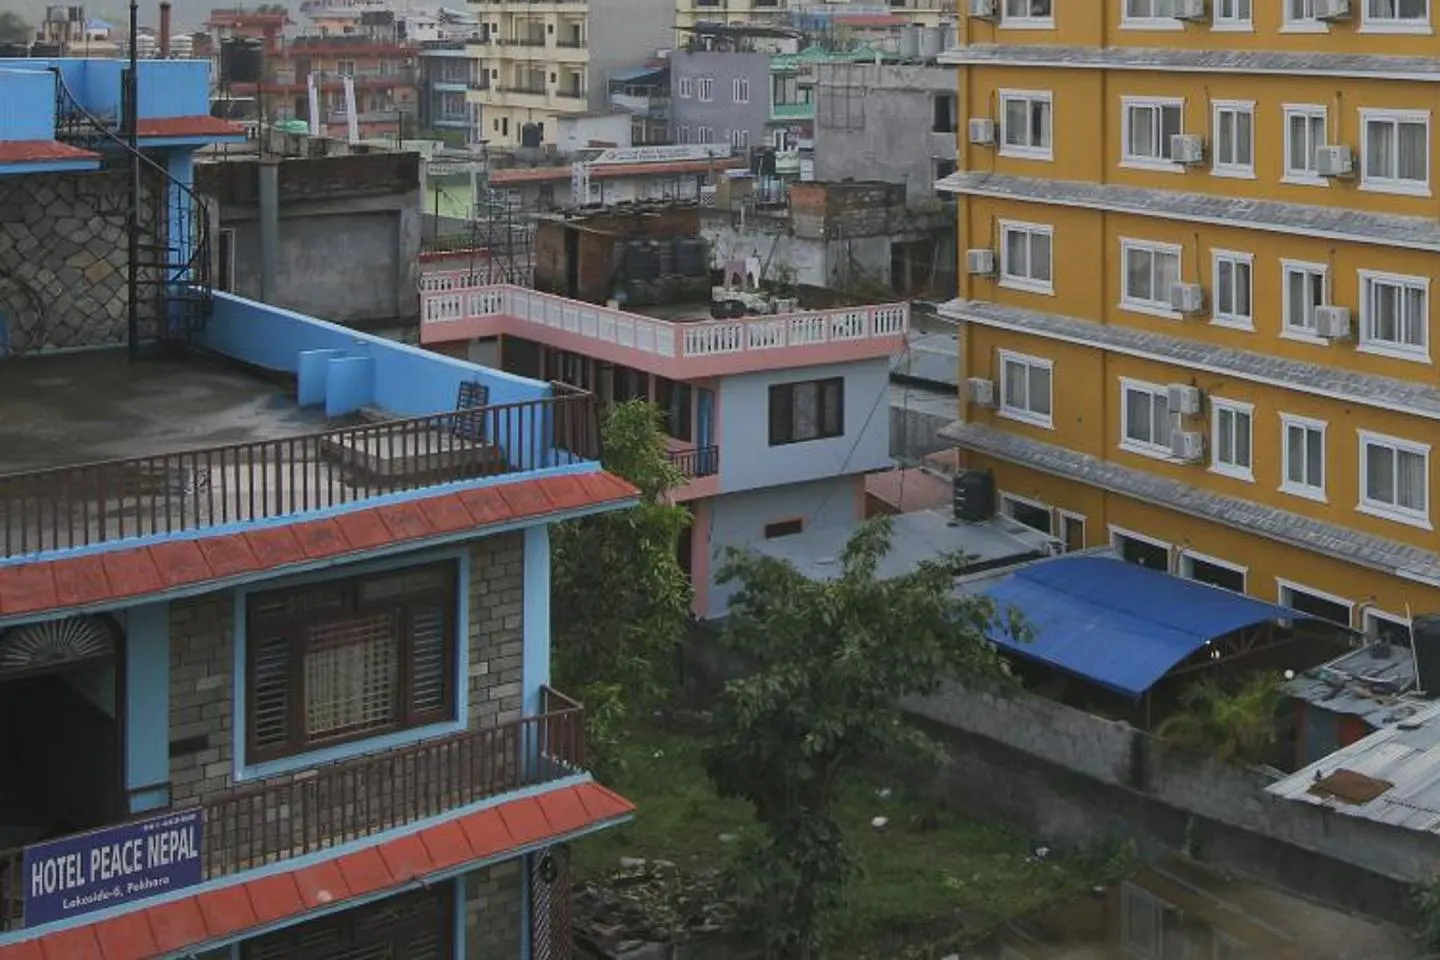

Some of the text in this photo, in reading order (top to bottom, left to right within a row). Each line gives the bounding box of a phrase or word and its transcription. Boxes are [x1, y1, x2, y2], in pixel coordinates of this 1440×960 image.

[32, 825, 198, 897] HOTEL PEACE NEPAL
[127, 876, 170, 895] Pokhara
